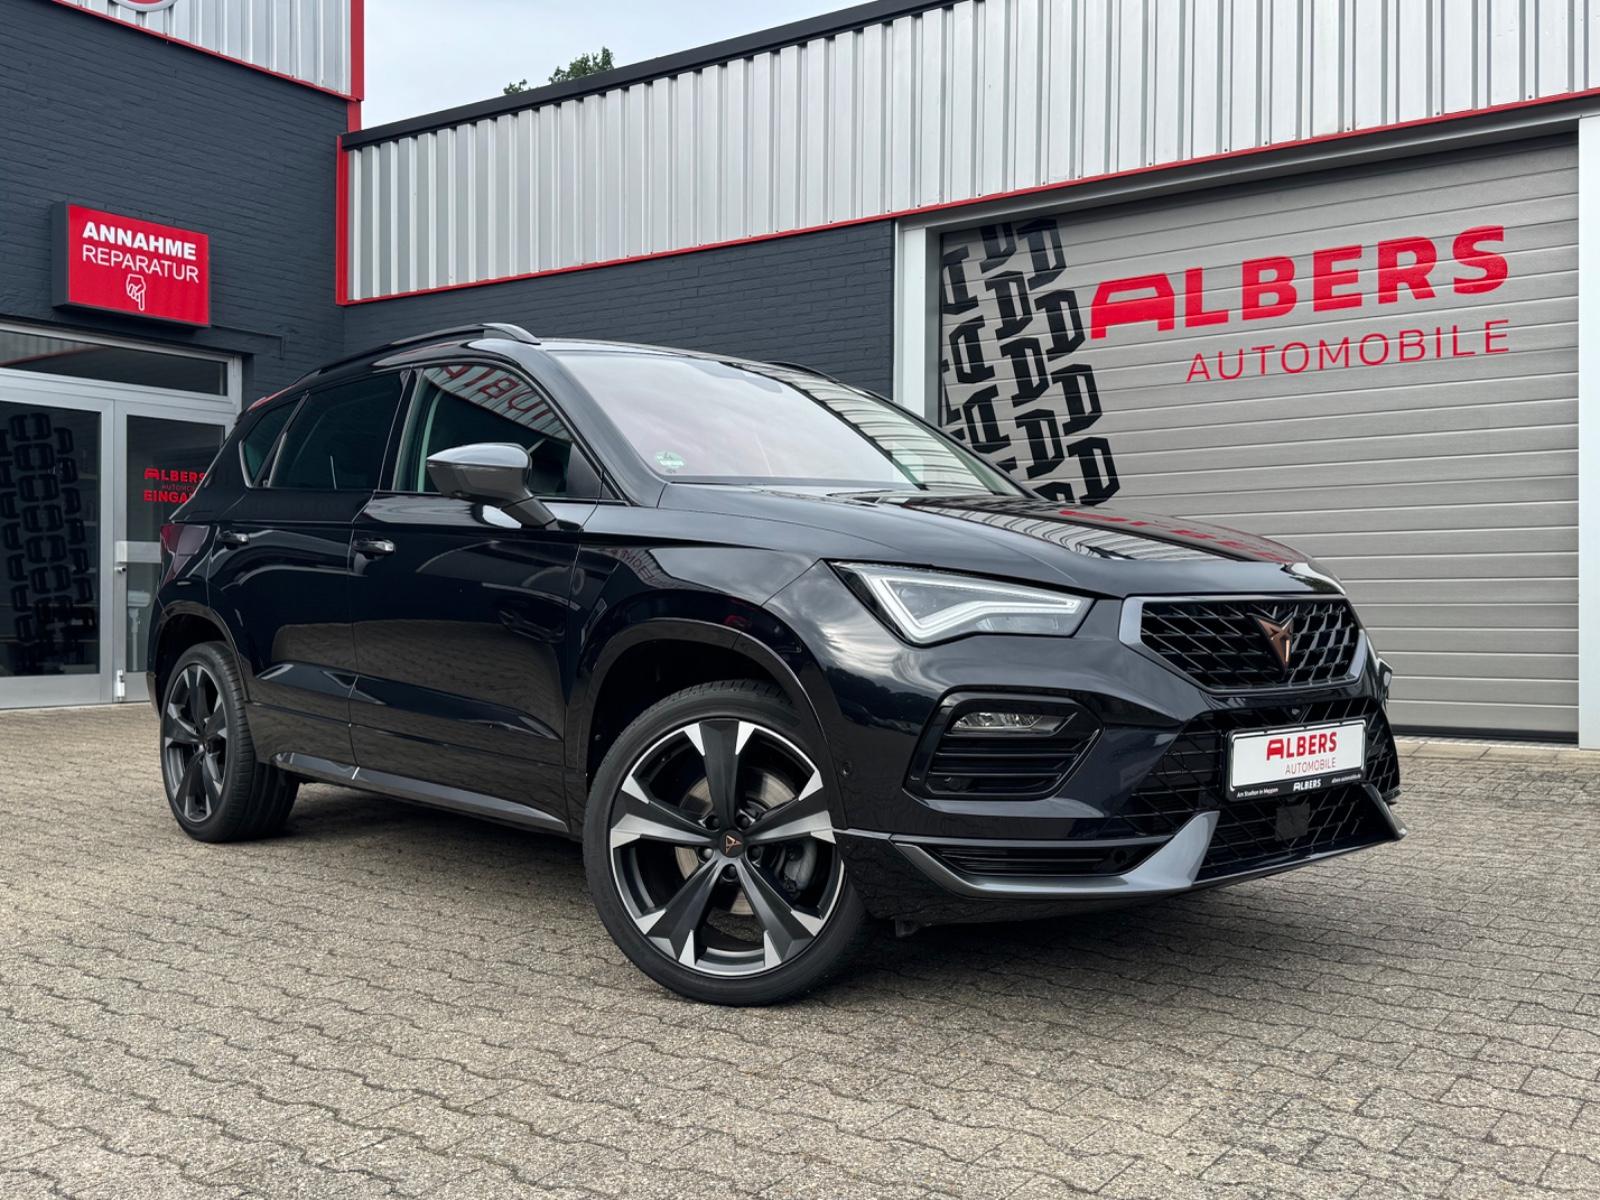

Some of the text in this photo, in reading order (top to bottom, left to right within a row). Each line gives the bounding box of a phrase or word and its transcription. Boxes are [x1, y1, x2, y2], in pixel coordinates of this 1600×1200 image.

[82, 221, 197, 261] ANNAHME
[82, 244, 199, 283] REPARATUR
[1090, 224, 1509, 340] ALBERS
[1185, 319, 1510, 383] AUTOMOBILE
[143, 489, 192, 504] EINGA
[1266, 731, 1338, 761] ALBERS
[1285, 757, 1336, 775] AUTOMOBILE
[1292, 778, 1322, 792] ALBERS
